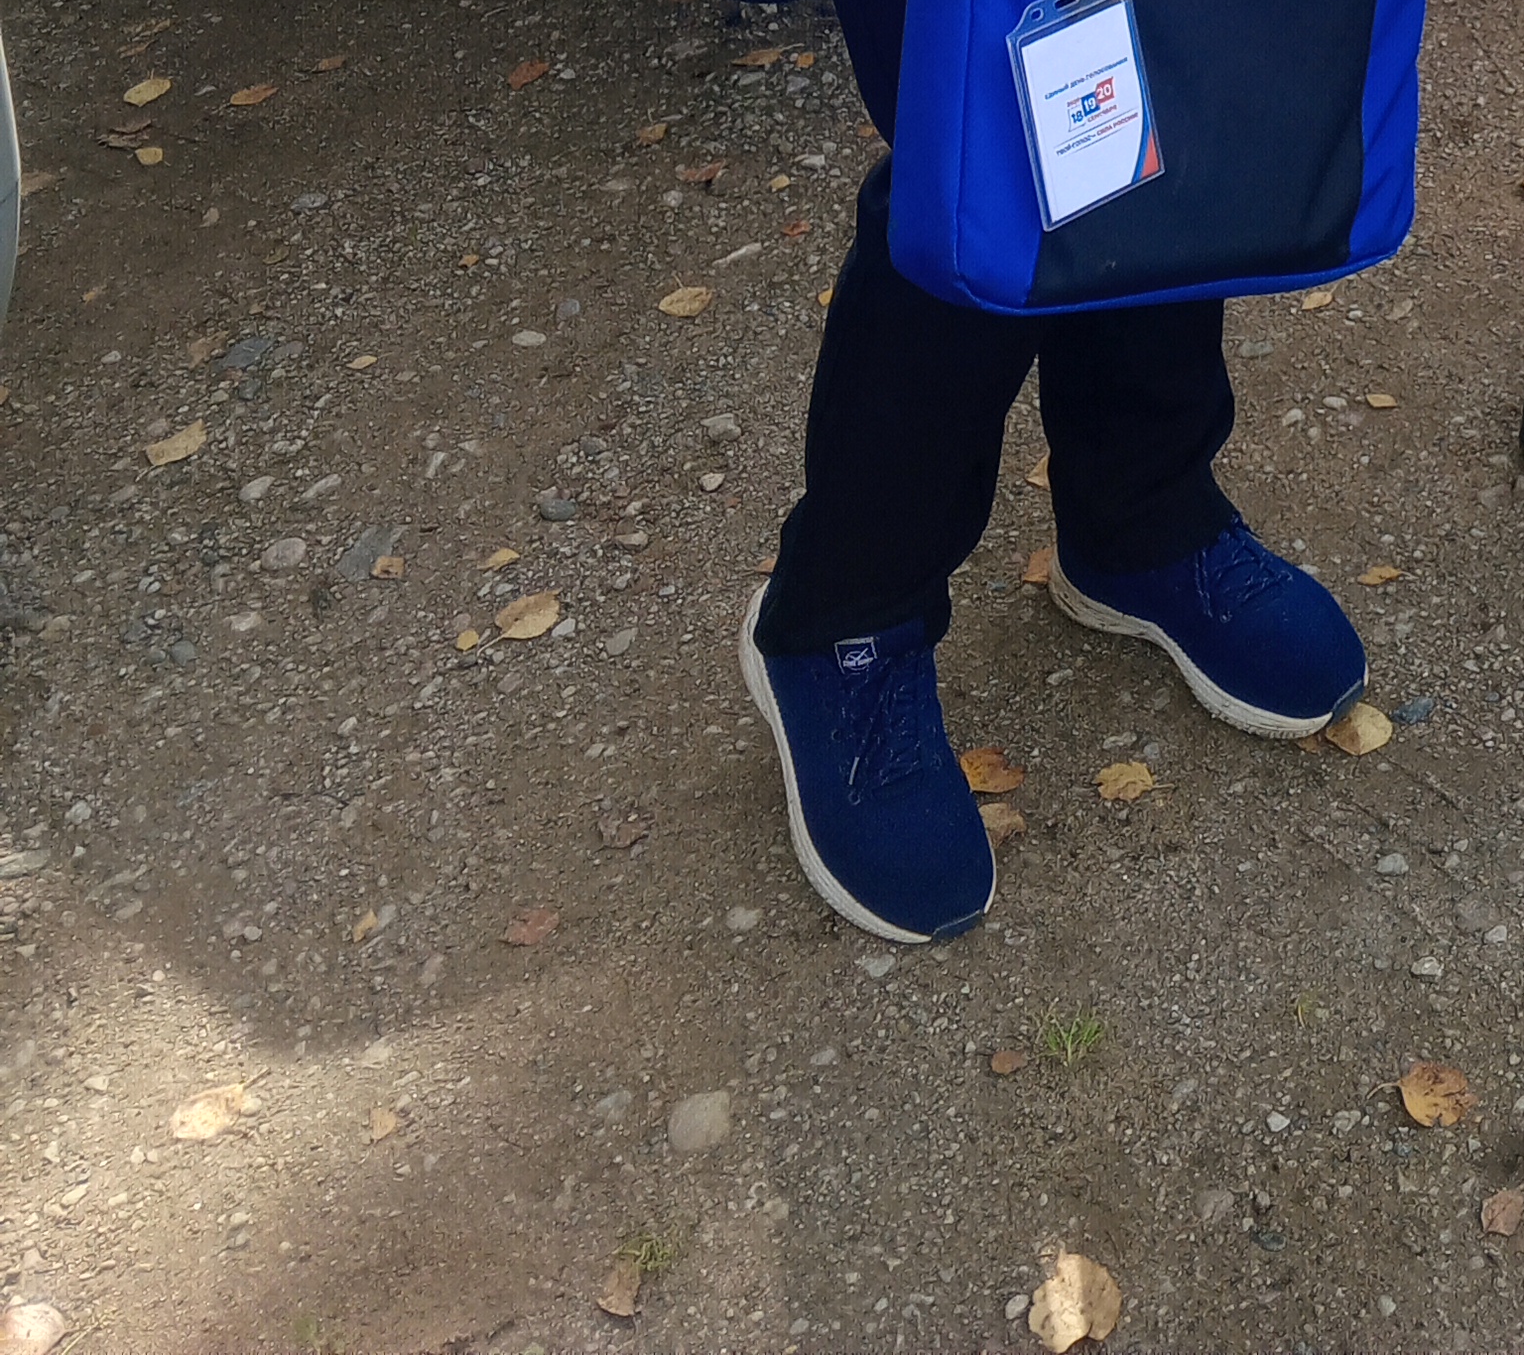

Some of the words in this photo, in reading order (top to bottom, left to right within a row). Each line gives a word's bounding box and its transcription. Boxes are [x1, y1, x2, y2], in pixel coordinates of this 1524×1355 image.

[1071, 110, 1084, 124] 18
[1083, 97, 1096, 112] 19
[1096, 84, 1112, 99] 20
